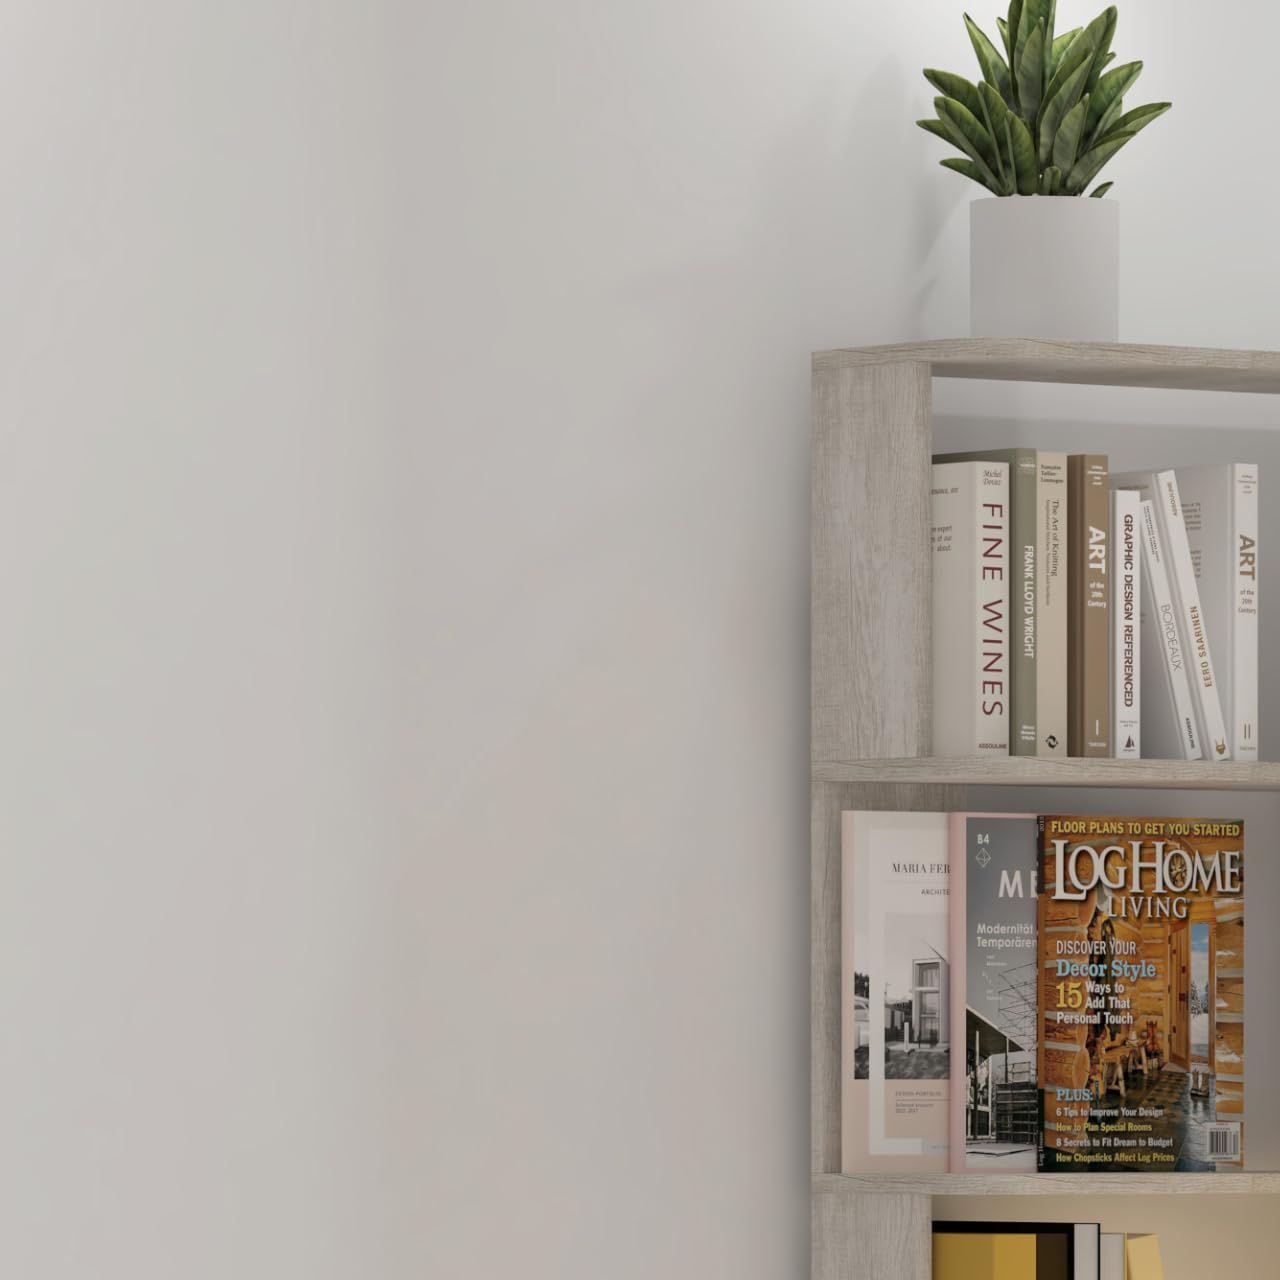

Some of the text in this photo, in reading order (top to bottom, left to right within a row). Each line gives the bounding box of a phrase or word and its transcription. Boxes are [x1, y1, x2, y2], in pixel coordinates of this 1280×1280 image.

[1088, 525, 1106, 575] ART
[1239, 534, 1256, 581] ART
[1050, 543, 1059, 577] Knitting
[982, 503, 1003, 716] FINE WINES
[1023, 545, 1034, 659] FRANK LLOYD WRIGHT
[1124, 514, 1133, 708] GRAPHIC DESIGN REFERENCED
[1161, 603, 1182, 672] BORDEAUX
[1189, 606, 1212, 688] EERO SAARINEN
[1051, 821, 1240, 836] FLOOR PLANS TO GET YOU STARTED
[892, 863, 927, 874] MARIA
[1108, 896, 1188, 919] LIVING
[976, 923, 1034, 935] Modernität
[1056, 940, 1136, 955] DISCOVER YOUR
[1056, 959, 1157, 982] Decor Style
[1055, 981, 1083, 1009] 15
[1085, 981, 1125, 995] Ways to
[1085, 996, 1130, 1009] Add That
[1056, 1012, 1134, 1024] Personal Touch
[1056, 1088, 1093, 1101] PLUS:
[1056, 1107, 1164, 1118] 6 Tips to Improve Your Design
[1056, 1122, 1152, 1132] How to Plan Special Rooms
[1056, 1138, 1174, 1148] 8 Secrets to Fit Dream to Budget
[1056, 1153, 1072, 1162] How
[1114, 1153, 1137, 1162] Affect
[1138, 1153, 1151, 1163] Log
[1152, 1153, 1175, 1162] Prices
